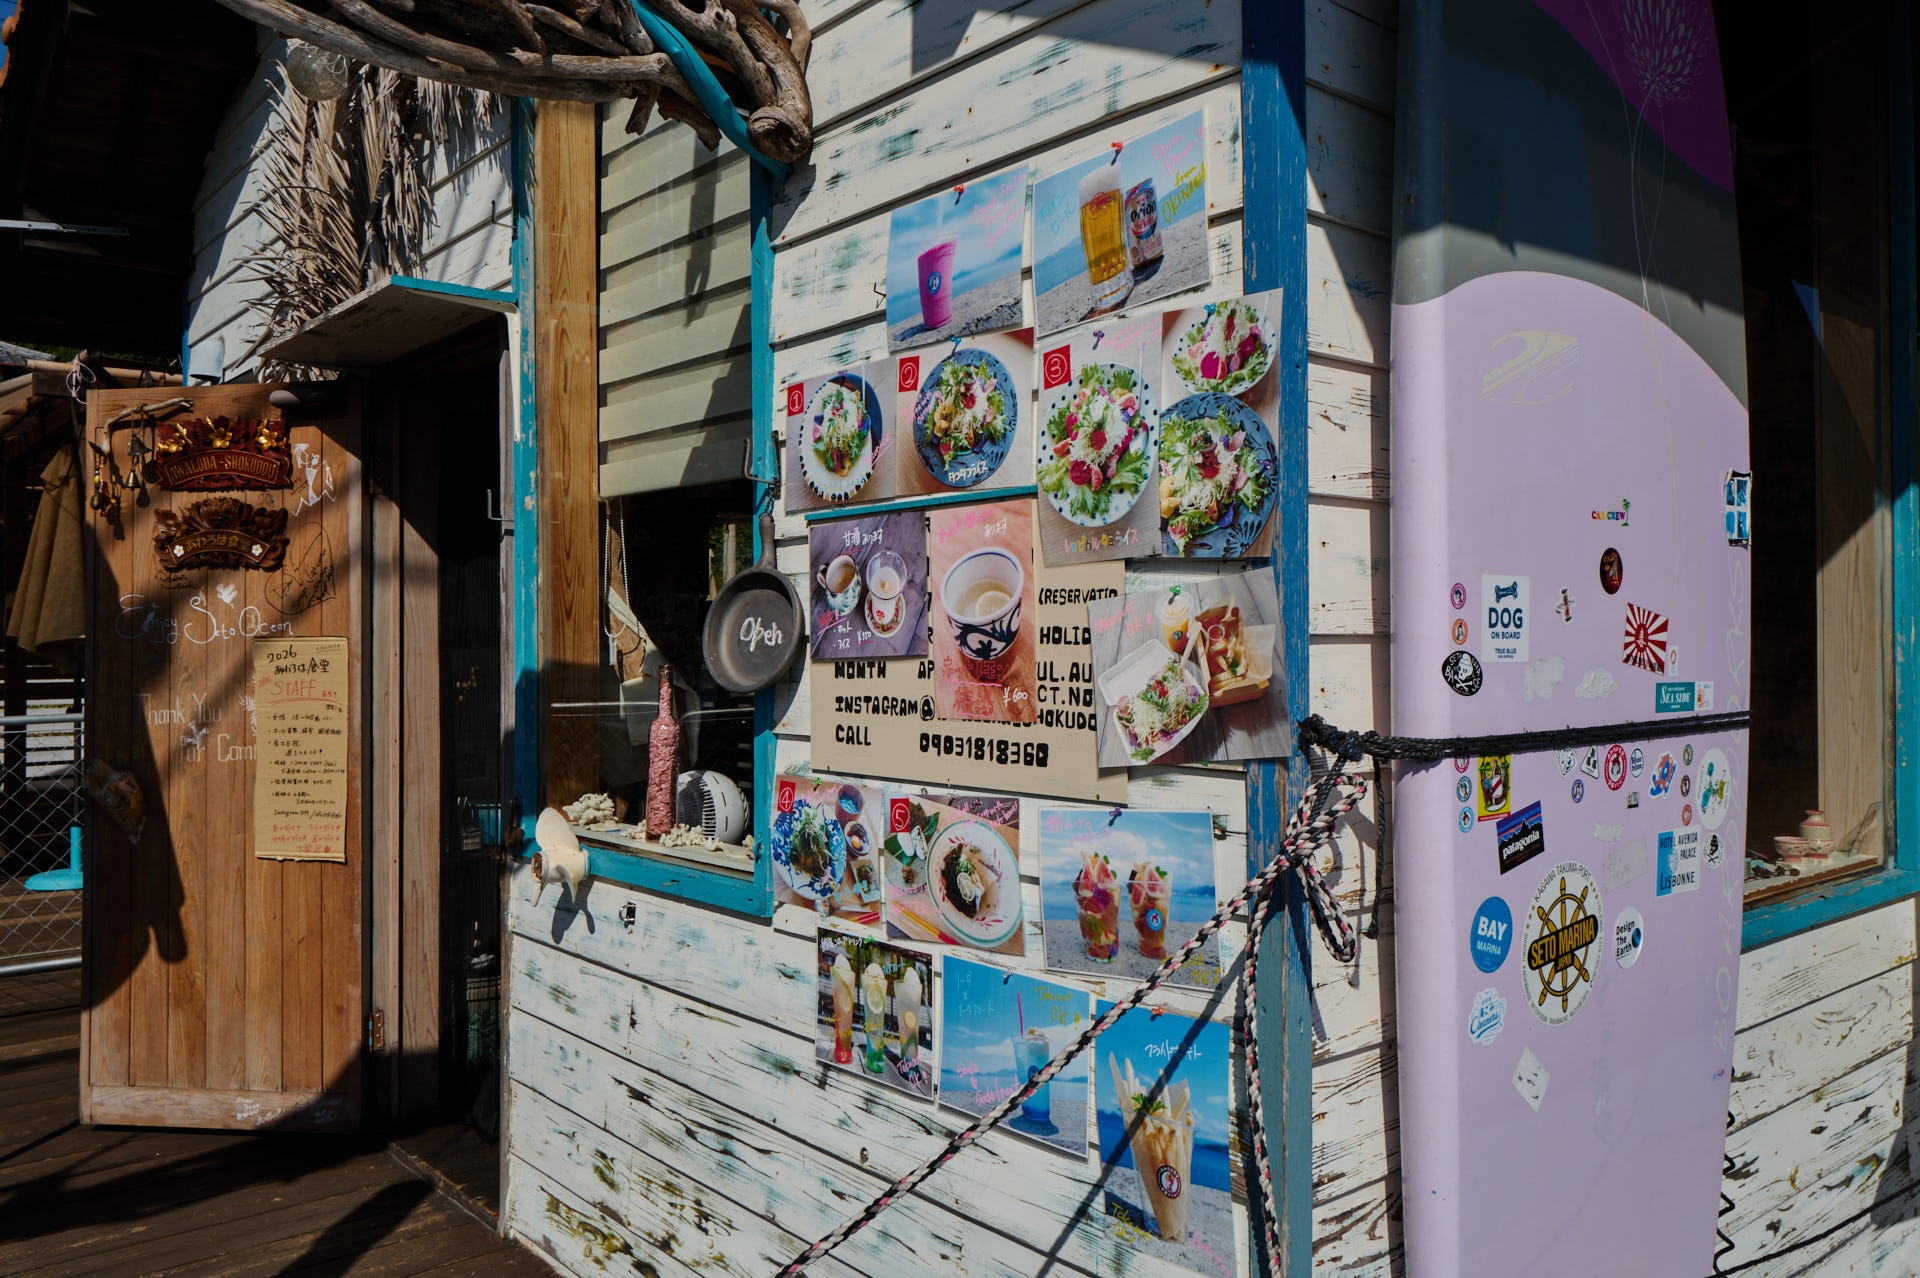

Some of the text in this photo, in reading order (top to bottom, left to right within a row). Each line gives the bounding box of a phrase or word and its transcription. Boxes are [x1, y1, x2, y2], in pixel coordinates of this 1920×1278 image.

[1488, 607, 1523, 629] DOG
[1491, 631, 1521, 640] ON BOARD
[267, 644, 297, 664] 2026
[834, 660, 887, 680] MONTH
[271, 678, 317, 698] STAFF
[835, 695, 918, 716] INSTAGRAM
[835, 724, 871, 746] CALL
[919, 732, 1049, 767] 09031818360
[1502, 830, 1540, 860] patagonia
[1659, 836, 1677, 850] HOTEL
[1680, 846, 1697, 860] PALACE
[1477, 915, 1508, 941] BAY
[1616, 920, 1635, 936] Design
[1476, 940, 1502, 956] MARINA
[1531, 917, 1596, 969] SETO MARINA
[1616, 936, 1627, 946] The
[1616, 943, 1632, 957] Earth
